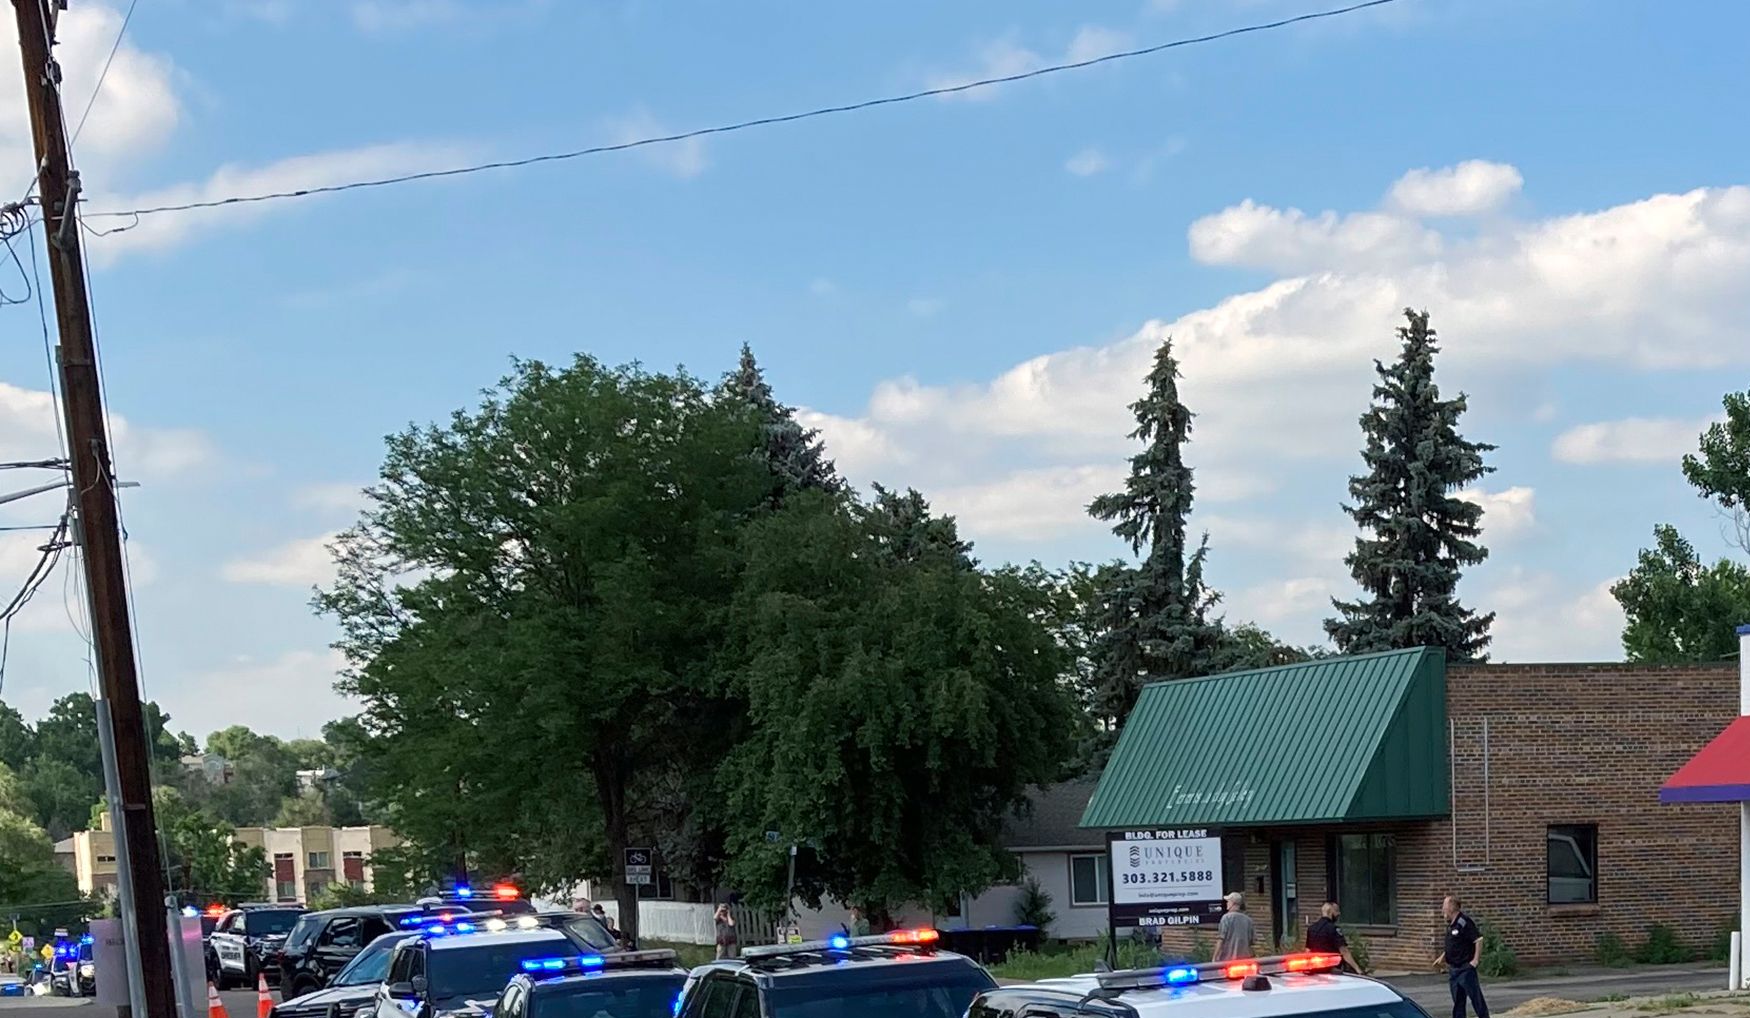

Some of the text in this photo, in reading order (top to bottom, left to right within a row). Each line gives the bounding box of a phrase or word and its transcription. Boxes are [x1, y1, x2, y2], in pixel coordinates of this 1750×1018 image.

[1156, 830, 1175, 839] FOR
[1177, 829, 1207, 838] LEASE
[1144, 845, 1204, 859] UNIQUE
[1122, 870, 1213, 884] 303.321.5888
[1139, 915, 1200, 926] BRAD GILPIN
